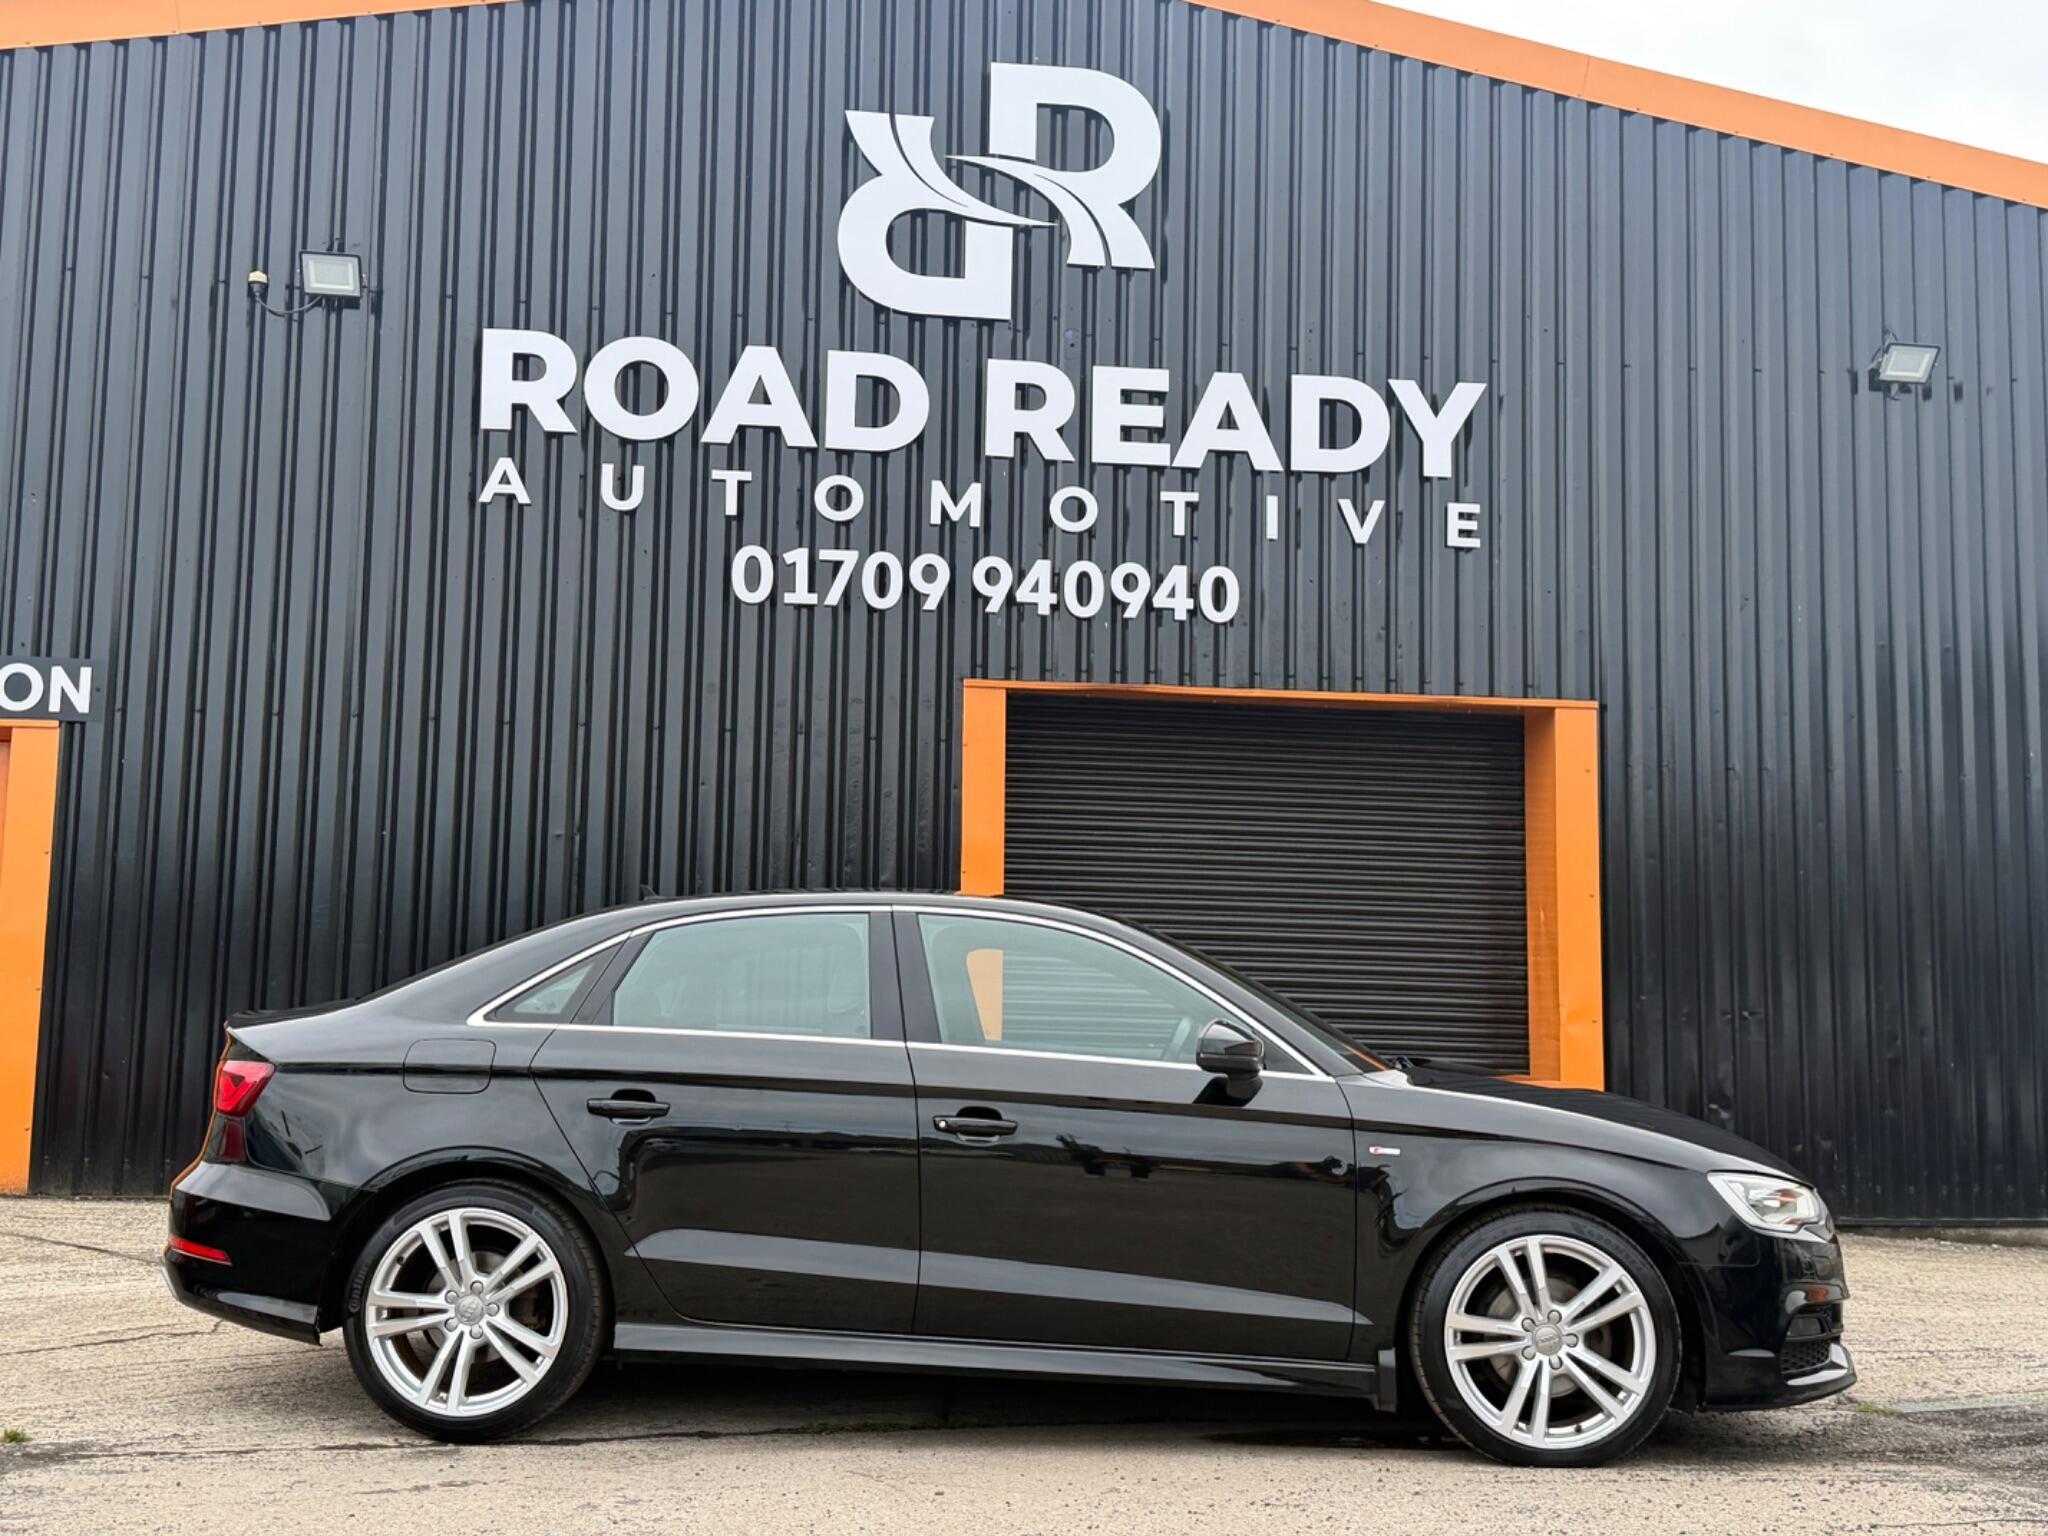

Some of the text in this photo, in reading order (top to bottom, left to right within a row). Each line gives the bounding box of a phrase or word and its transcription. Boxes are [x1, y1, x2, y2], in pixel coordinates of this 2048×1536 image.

[479, 327, 1488, 479] ROAD READY
[478, 456, 1482, 549] AUTOMOTIVE
[731, 544, 1240, 623] 01709 940940
